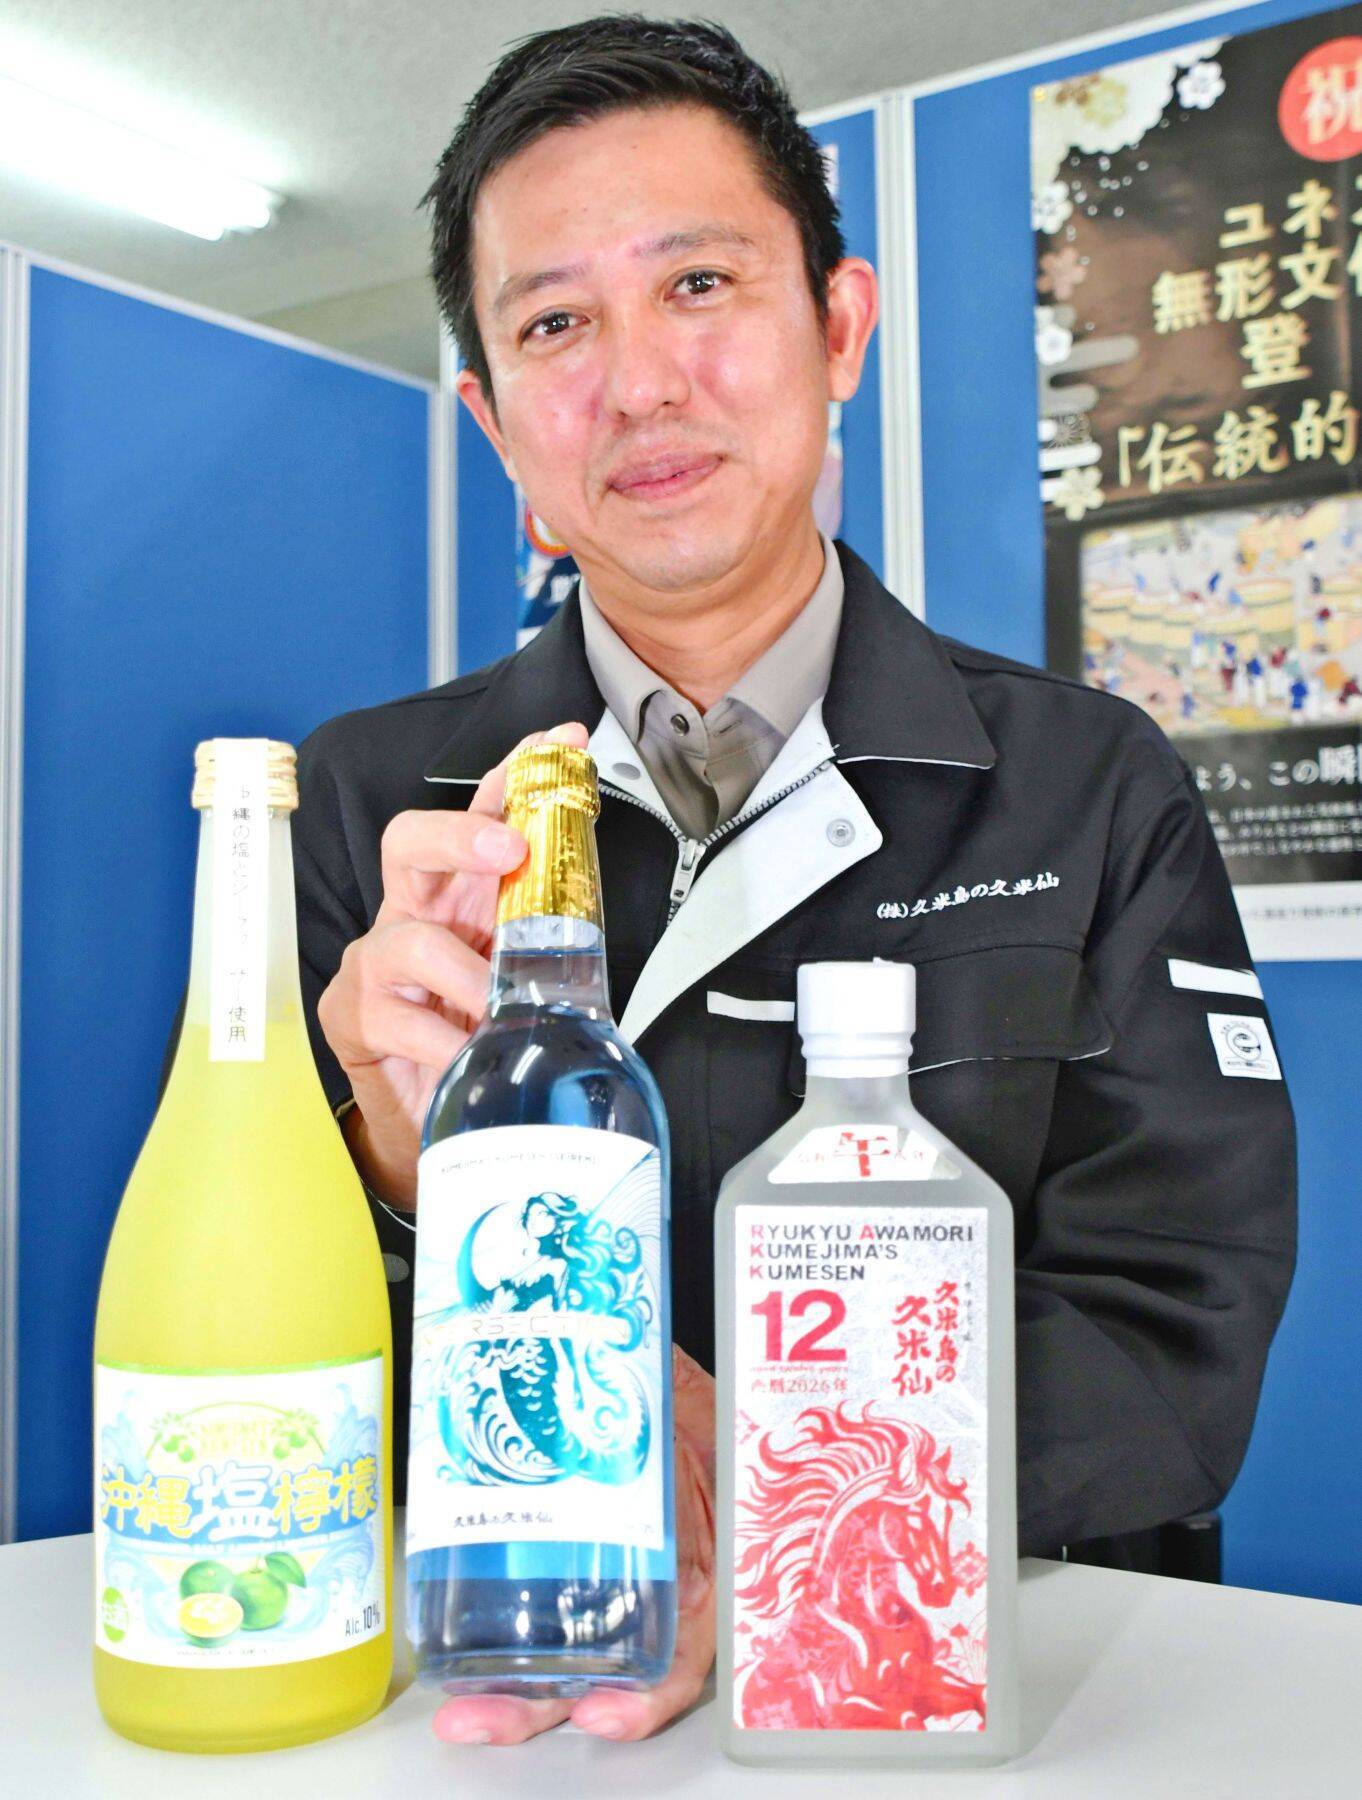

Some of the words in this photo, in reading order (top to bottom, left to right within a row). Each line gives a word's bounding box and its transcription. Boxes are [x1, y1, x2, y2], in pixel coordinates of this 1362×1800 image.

[1303, 62, 1362, 145] 祝
[1218, 177, 1362, 249] ユネ
[1241, 312, 1311, 390] 登
[876, 872, 1060, 919] (株)久米島の久米仙
[750, 1225, 851, 1240] RYUKYU
[859, 1225, 973, 1241] AWAMORI
[750, 1244, 898, 1260] KUMEJIMA'S
[750, 1264, 865, 1280] KUMESEN
[751, 1289, 847, 1362] 12
[891, 1295, 932, 1397] 久米仙
[931, 1281, 960, 1383] 久米島の
